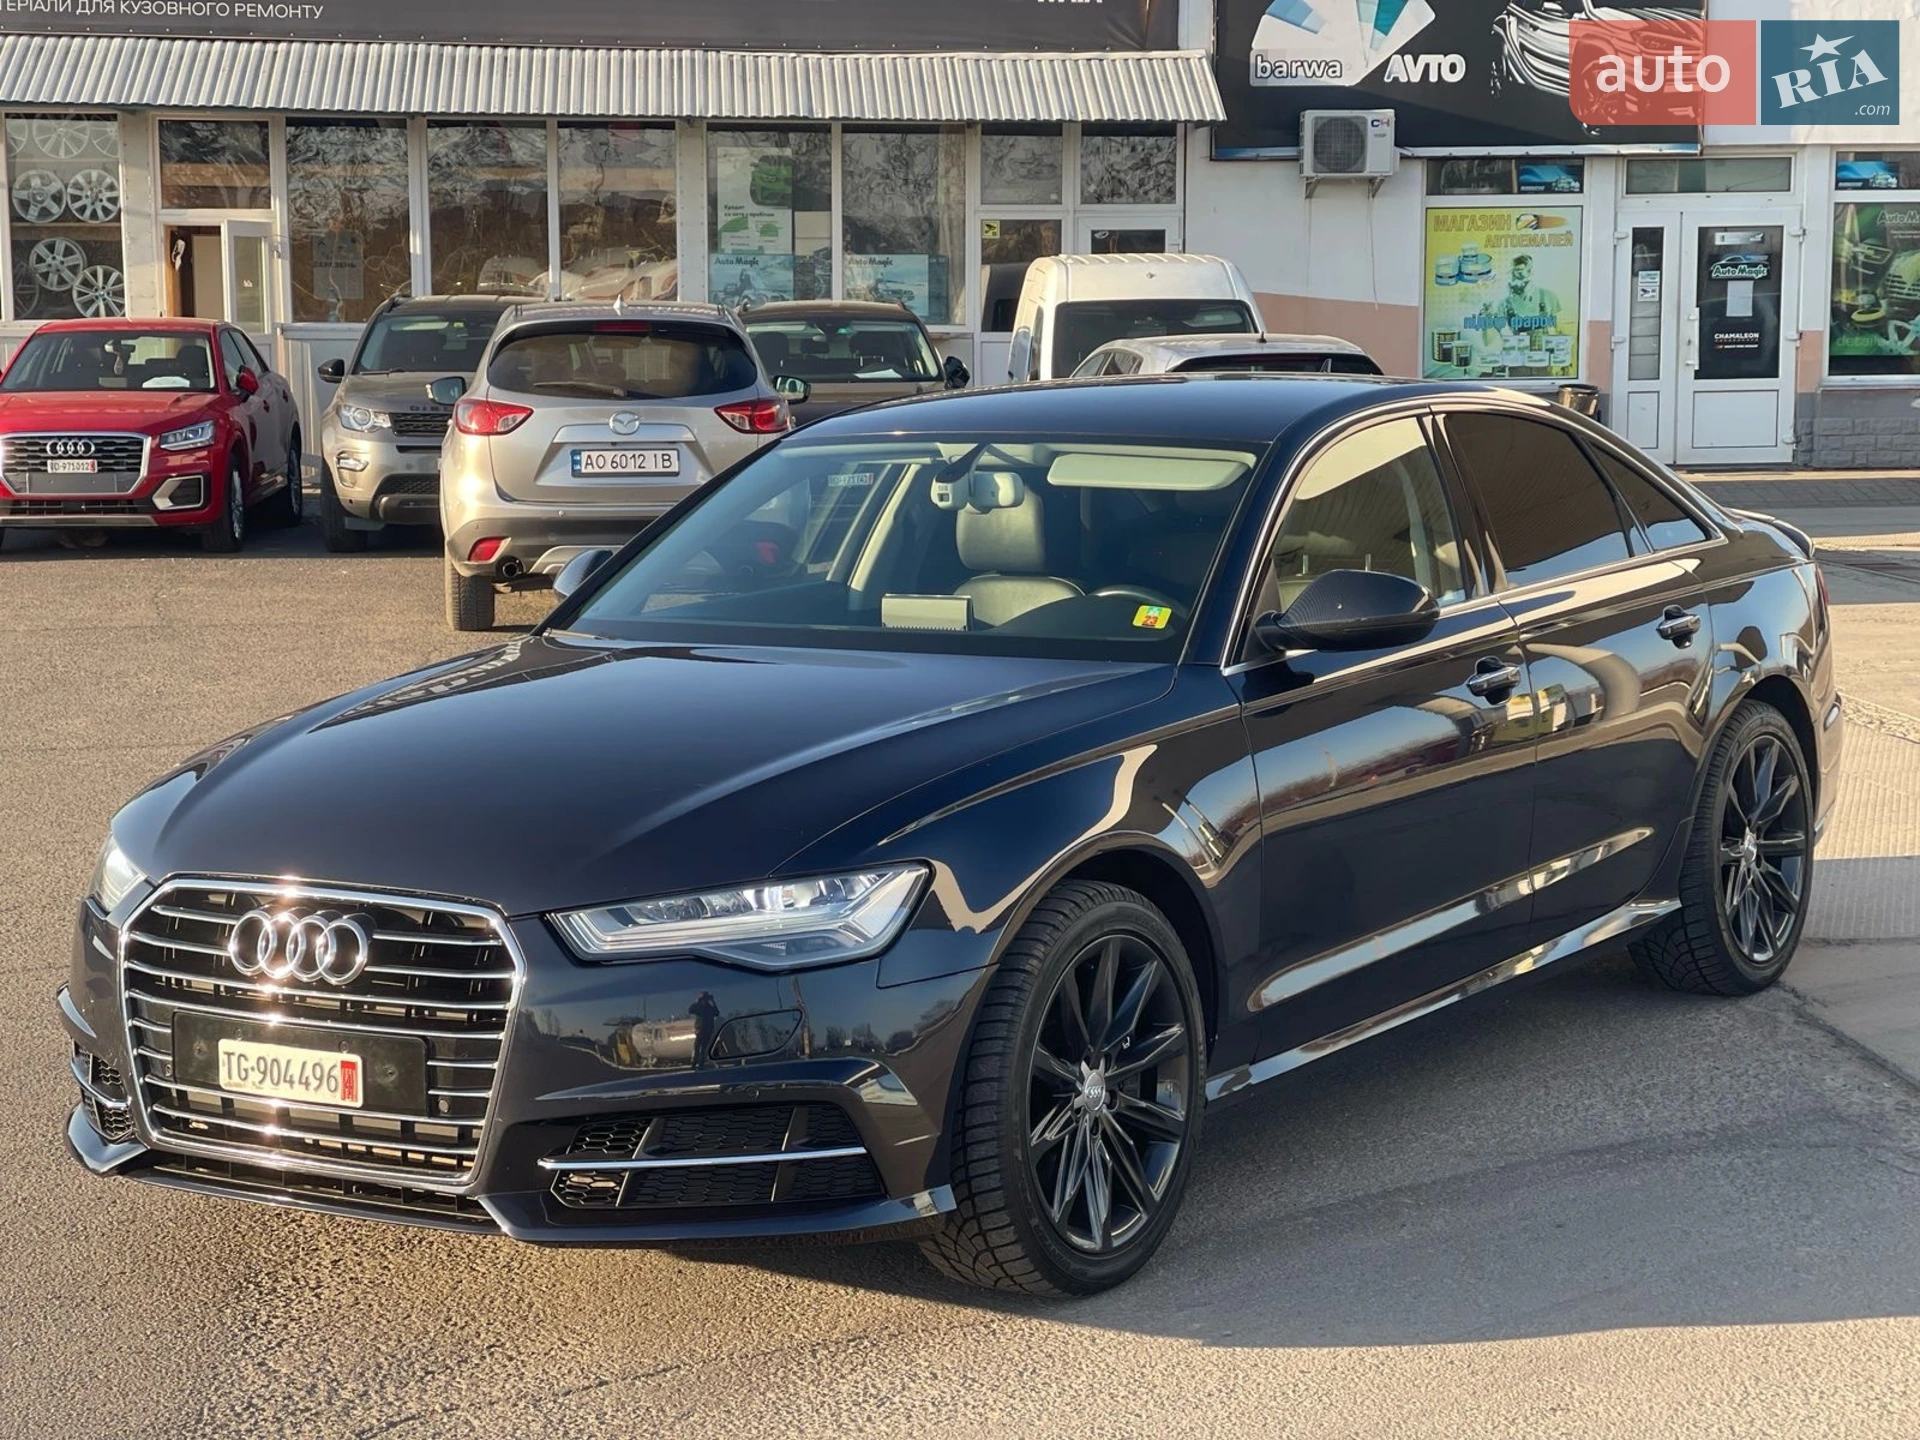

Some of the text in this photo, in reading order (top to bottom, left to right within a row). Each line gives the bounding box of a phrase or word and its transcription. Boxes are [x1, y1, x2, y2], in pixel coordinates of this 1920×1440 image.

[76, 0, 115, 15] ДЛЯ
[120, 0, 229, 17] КУЗОВНОГО
[235, 4, 324, 19] РЕМОНТУ
[1255, 54, 1343, 79] barwa
[1384, 53, 1467, 83] AVTO
[1433, 214, 1512, 232] МАГАЗИН
[1877, 210, 1905, 223] Auto
[1484, 230, 1574, 248] АВТОЕМАЛЕЙ
[714, 256, 759, 268] Auto Magic
[848, 256, 893, 268] Auto Magic
[1712, 264, 1767, 278] Auto Magic
[584, 453, 673, 470] AO 6012 IB
